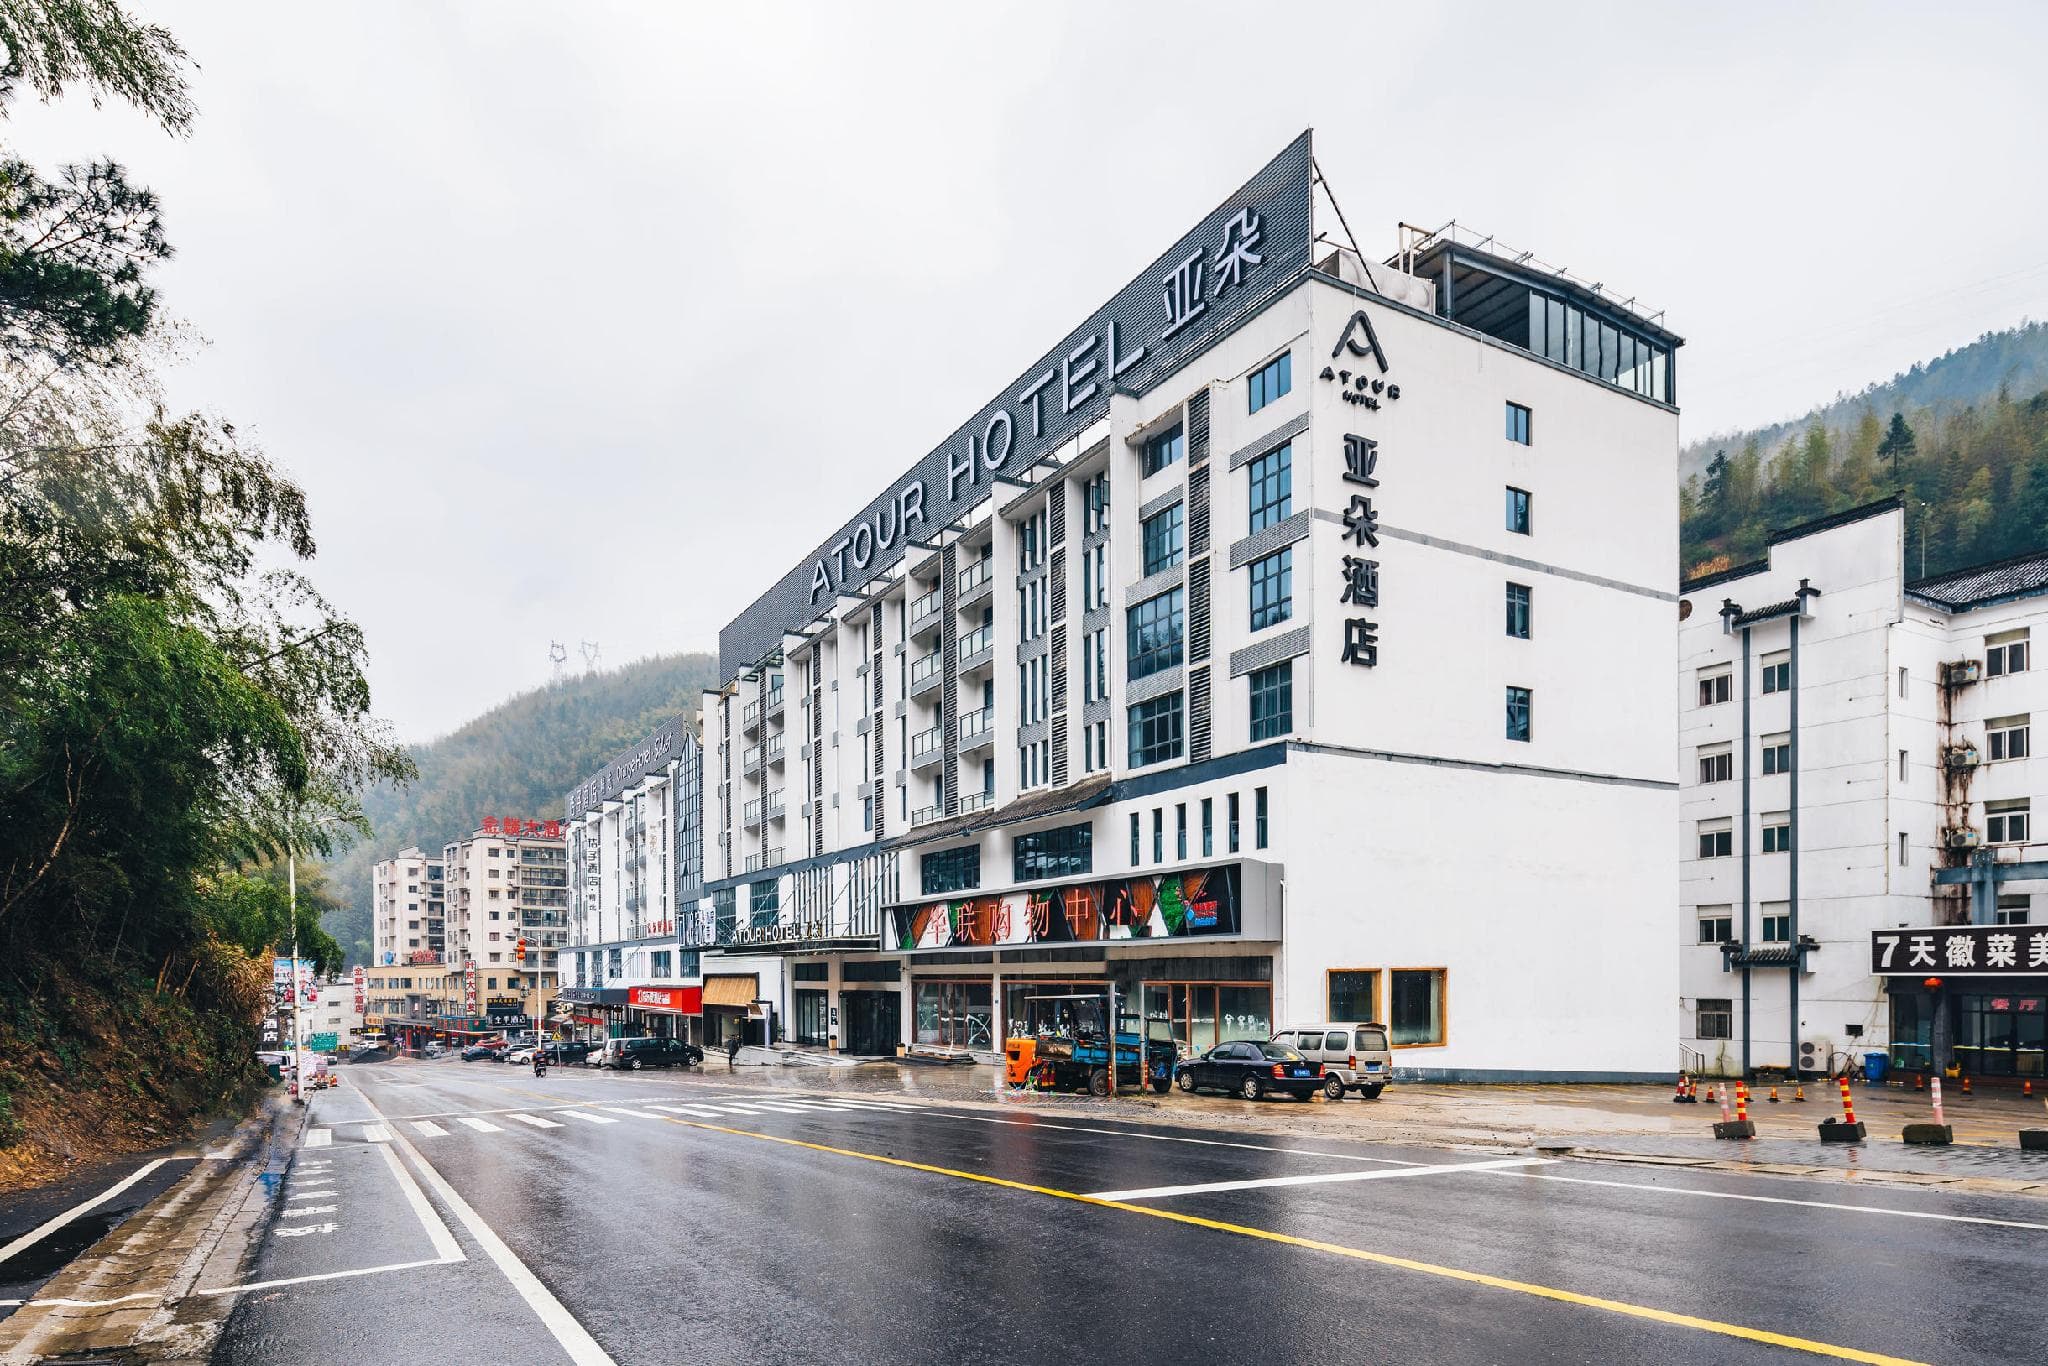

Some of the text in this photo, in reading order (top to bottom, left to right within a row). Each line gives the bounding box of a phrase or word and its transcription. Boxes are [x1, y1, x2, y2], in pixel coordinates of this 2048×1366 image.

[1162, 206, 1263, 340] 亚朵
[1319, 366, 1400, 400] ATOUR
[810, 320, 1145, 604] ATOUR HOTEL
[1341, 433, 1380, 667] 亚朵酒店
[731, 926, 765, 944] ATOUR
[766, 923, 800, 942] HOTEL
[927, 888, 1139, 945] 华联购物中心
